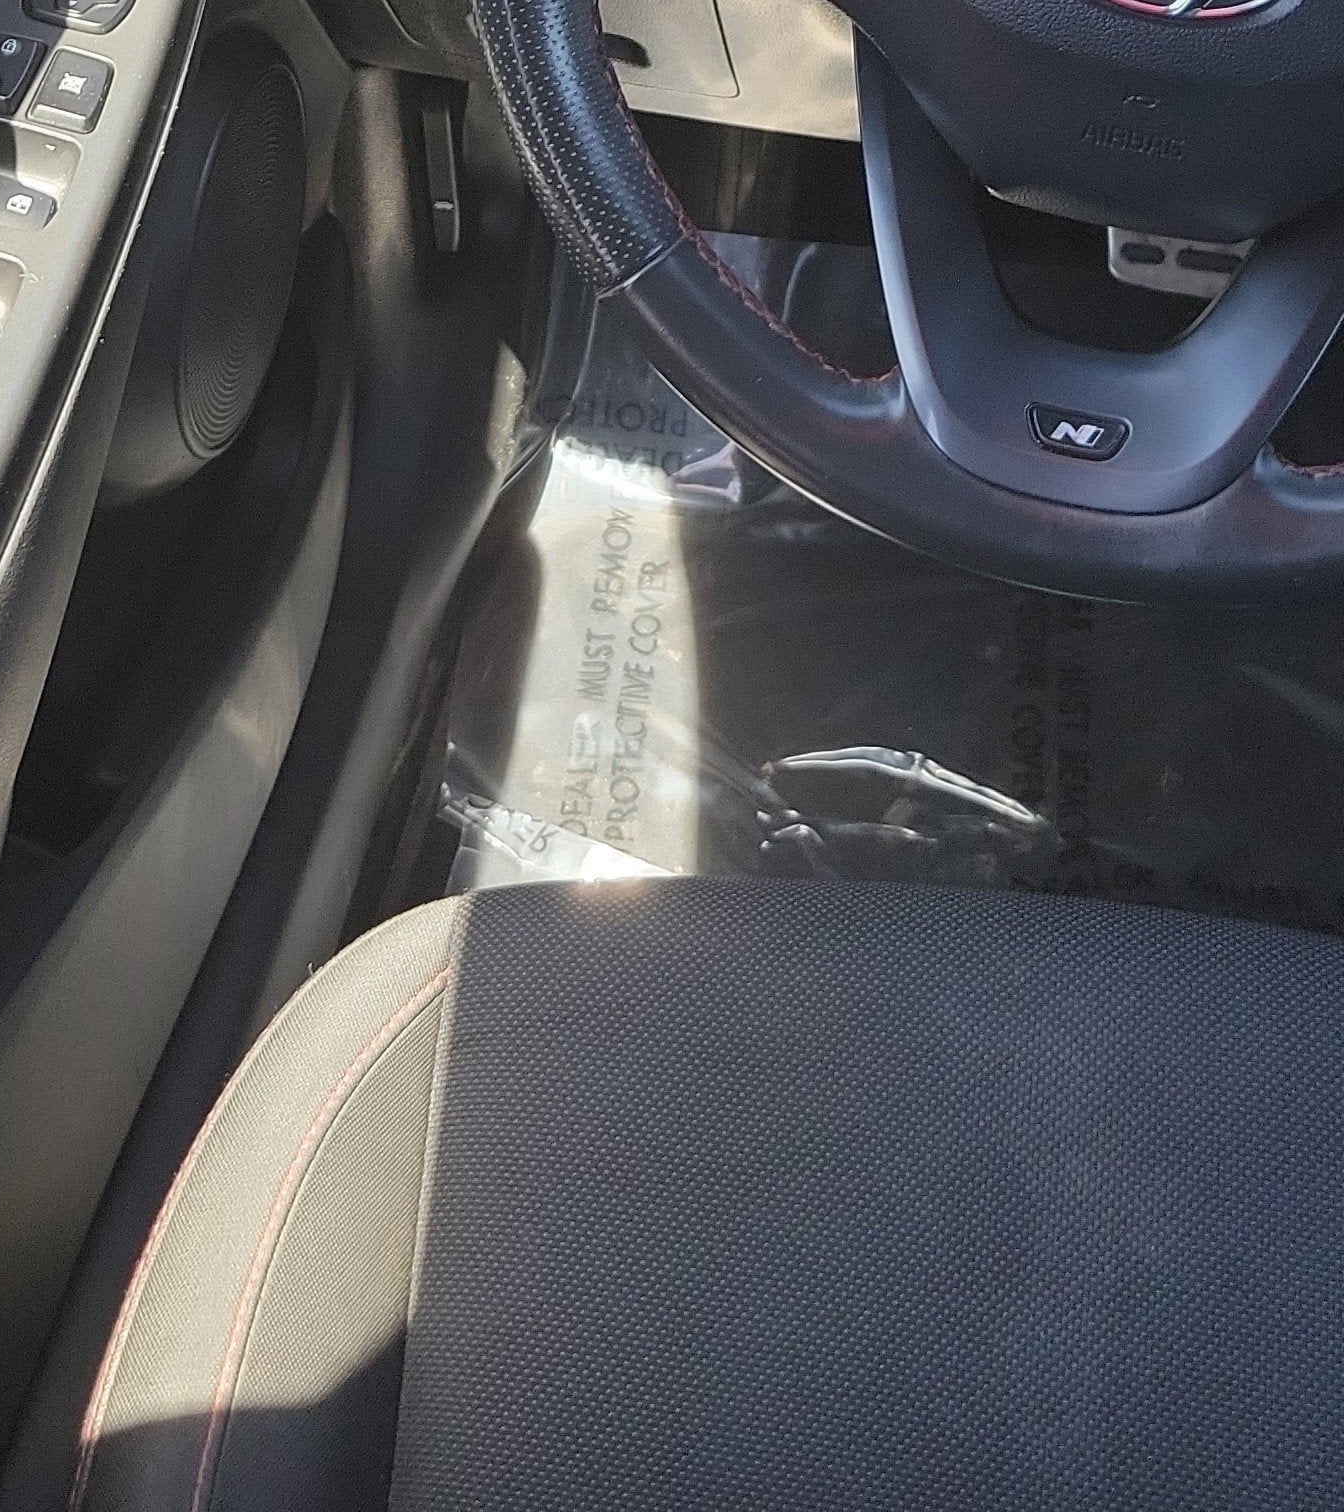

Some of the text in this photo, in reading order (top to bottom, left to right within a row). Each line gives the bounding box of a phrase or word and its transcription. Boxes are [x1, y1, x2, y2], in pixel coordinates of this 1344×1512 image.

[592, 507, 635, 614] REMOV
[578, 627, 616, 702] MUST
[605, 560, 671, 842] PROTECTIVE COVER
